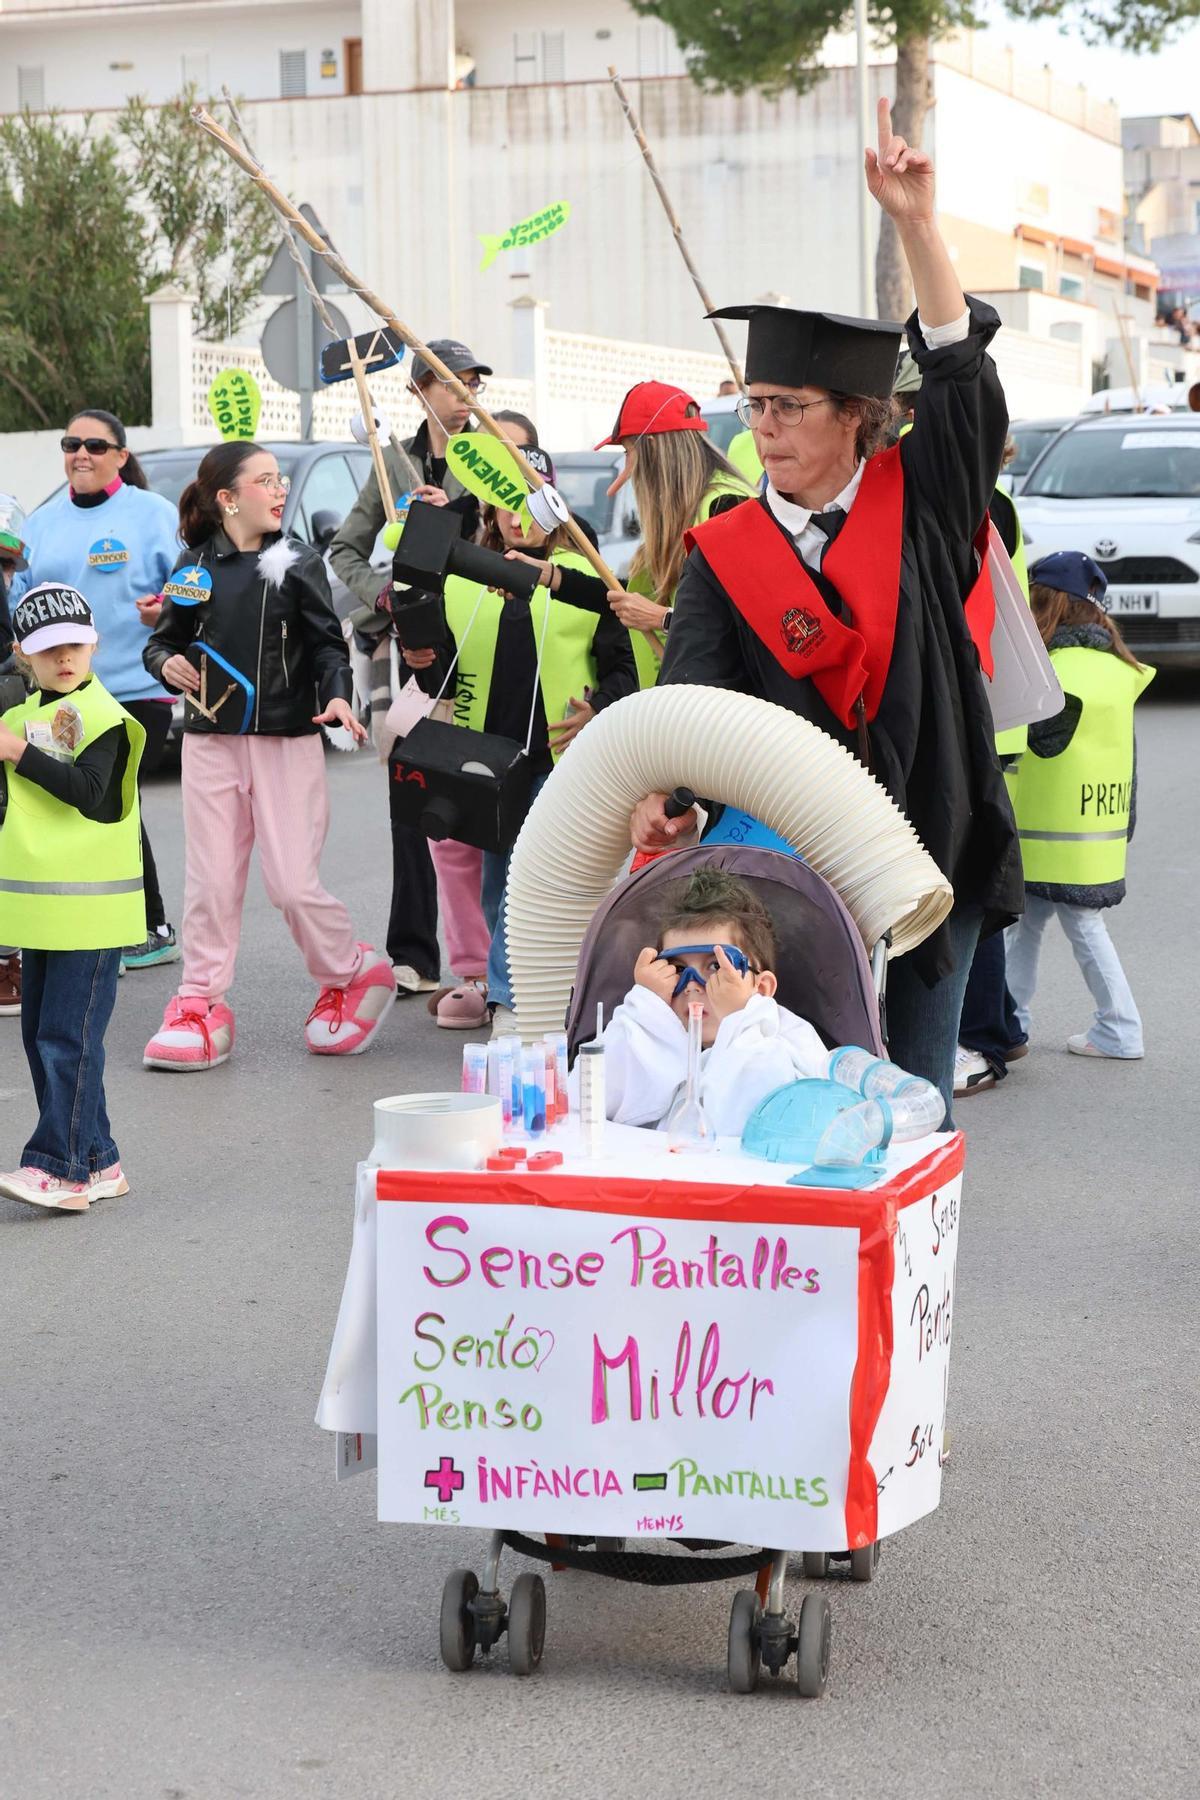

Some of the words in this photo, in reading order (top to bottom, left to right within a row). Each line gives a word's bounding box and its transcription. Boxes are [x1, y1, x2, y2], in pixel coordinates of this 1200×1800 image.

[214, 387, 236, 435] SOUS
[453, 440, 526, 511] VENENO
[89, 551, 129, 564] SPONSOR
[164, 583, 208, 600] SPONSOR
[394, 763, 427, 789] IA
[931, 1194, 957, 1256] Sense
[423, 1215, 605, 1290] Sense
[610, 1225, 821, 1294] Pantalles
[592, 1320, 774, 1425] Millor
[399, 1382, 542, 1432] Penso
[637, 1514, 684, 1531] MENYS
